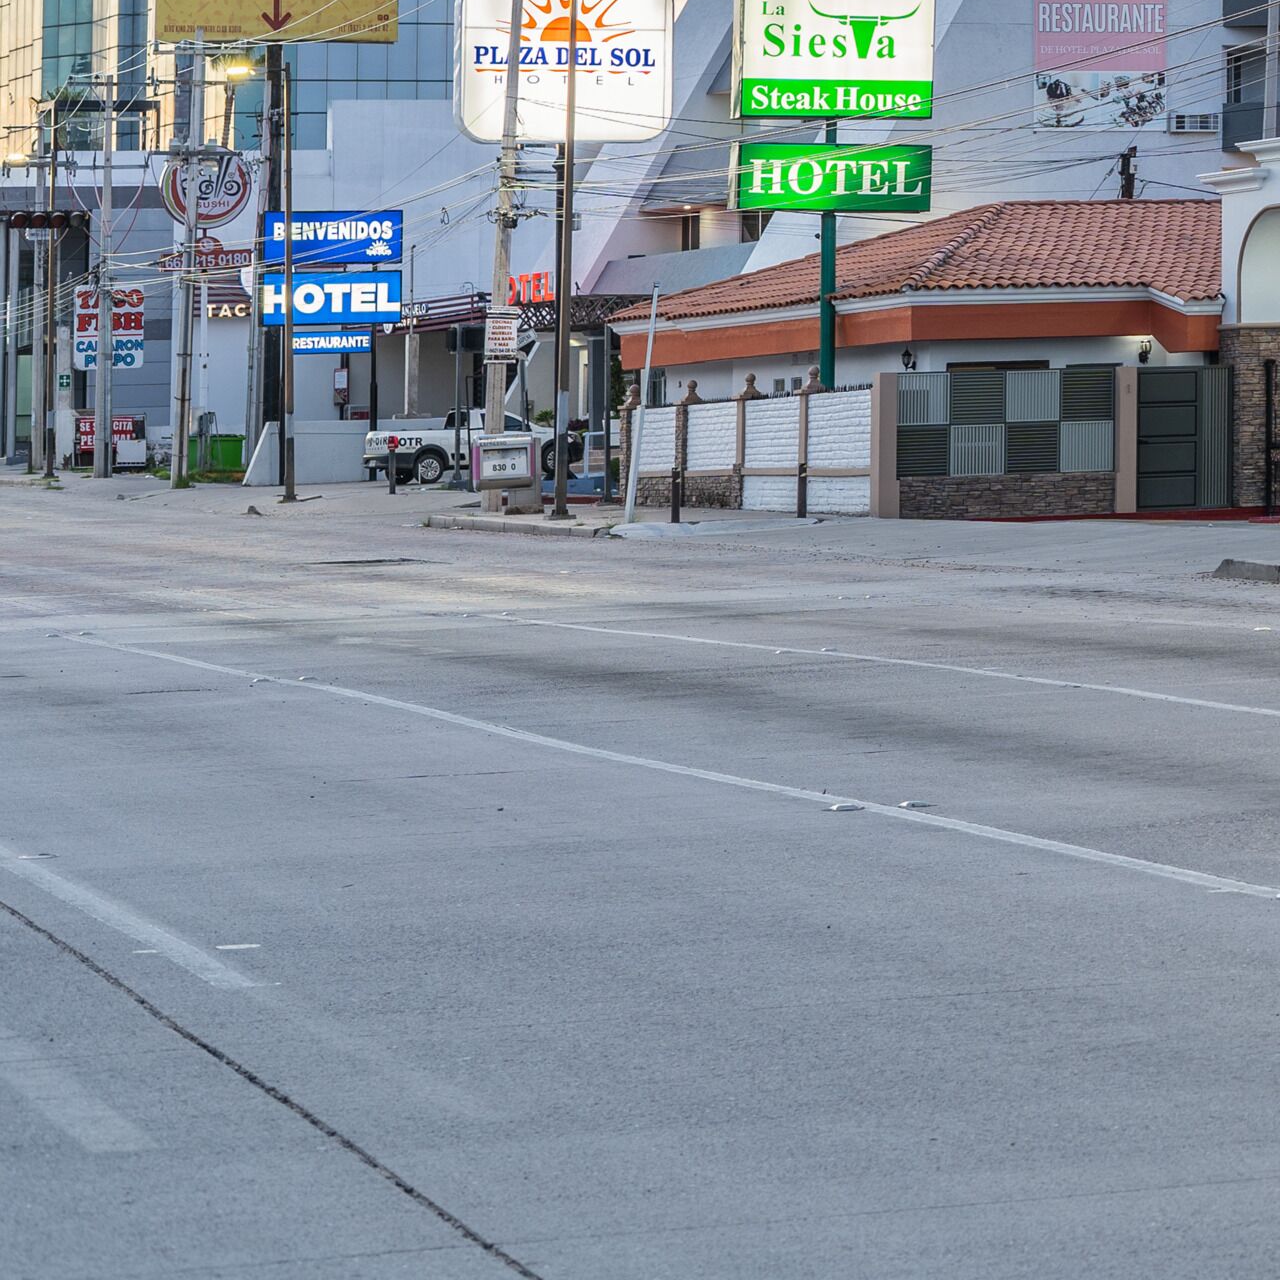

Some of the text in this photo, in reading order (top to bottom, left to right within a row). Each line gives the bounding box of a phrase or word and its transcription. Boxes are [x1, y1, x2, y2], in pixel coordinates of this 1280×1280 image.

[762, 0, 786, 17] La
[1038, 2, 1165, 33] RESTAURANTE
[474, 45, 656, 67] PLZA DEL SOL
[494, 75, 635, 86] HOTEL
[750, 85, 922, 113] Steak House
[748, 158, 923, 197] HOTEL
[273, 220, 393, 241] BENVENIDOS
[165, 257, 184, 269] 66
[218, 252, 250, 266] 0180
[507, 271, 555, 306] OTEL
[263, 282, 401, 314] HOTEL
[206, 304, 253, 318] TAC
[76, 339, 144, 353] CARON
[292, 335, 370, 350] RESTAURANTE
[84, 353, 136, 368] PPO
[80, 421, 133, 432] SE CITA
[81, 433, 131, 446] PENAL
